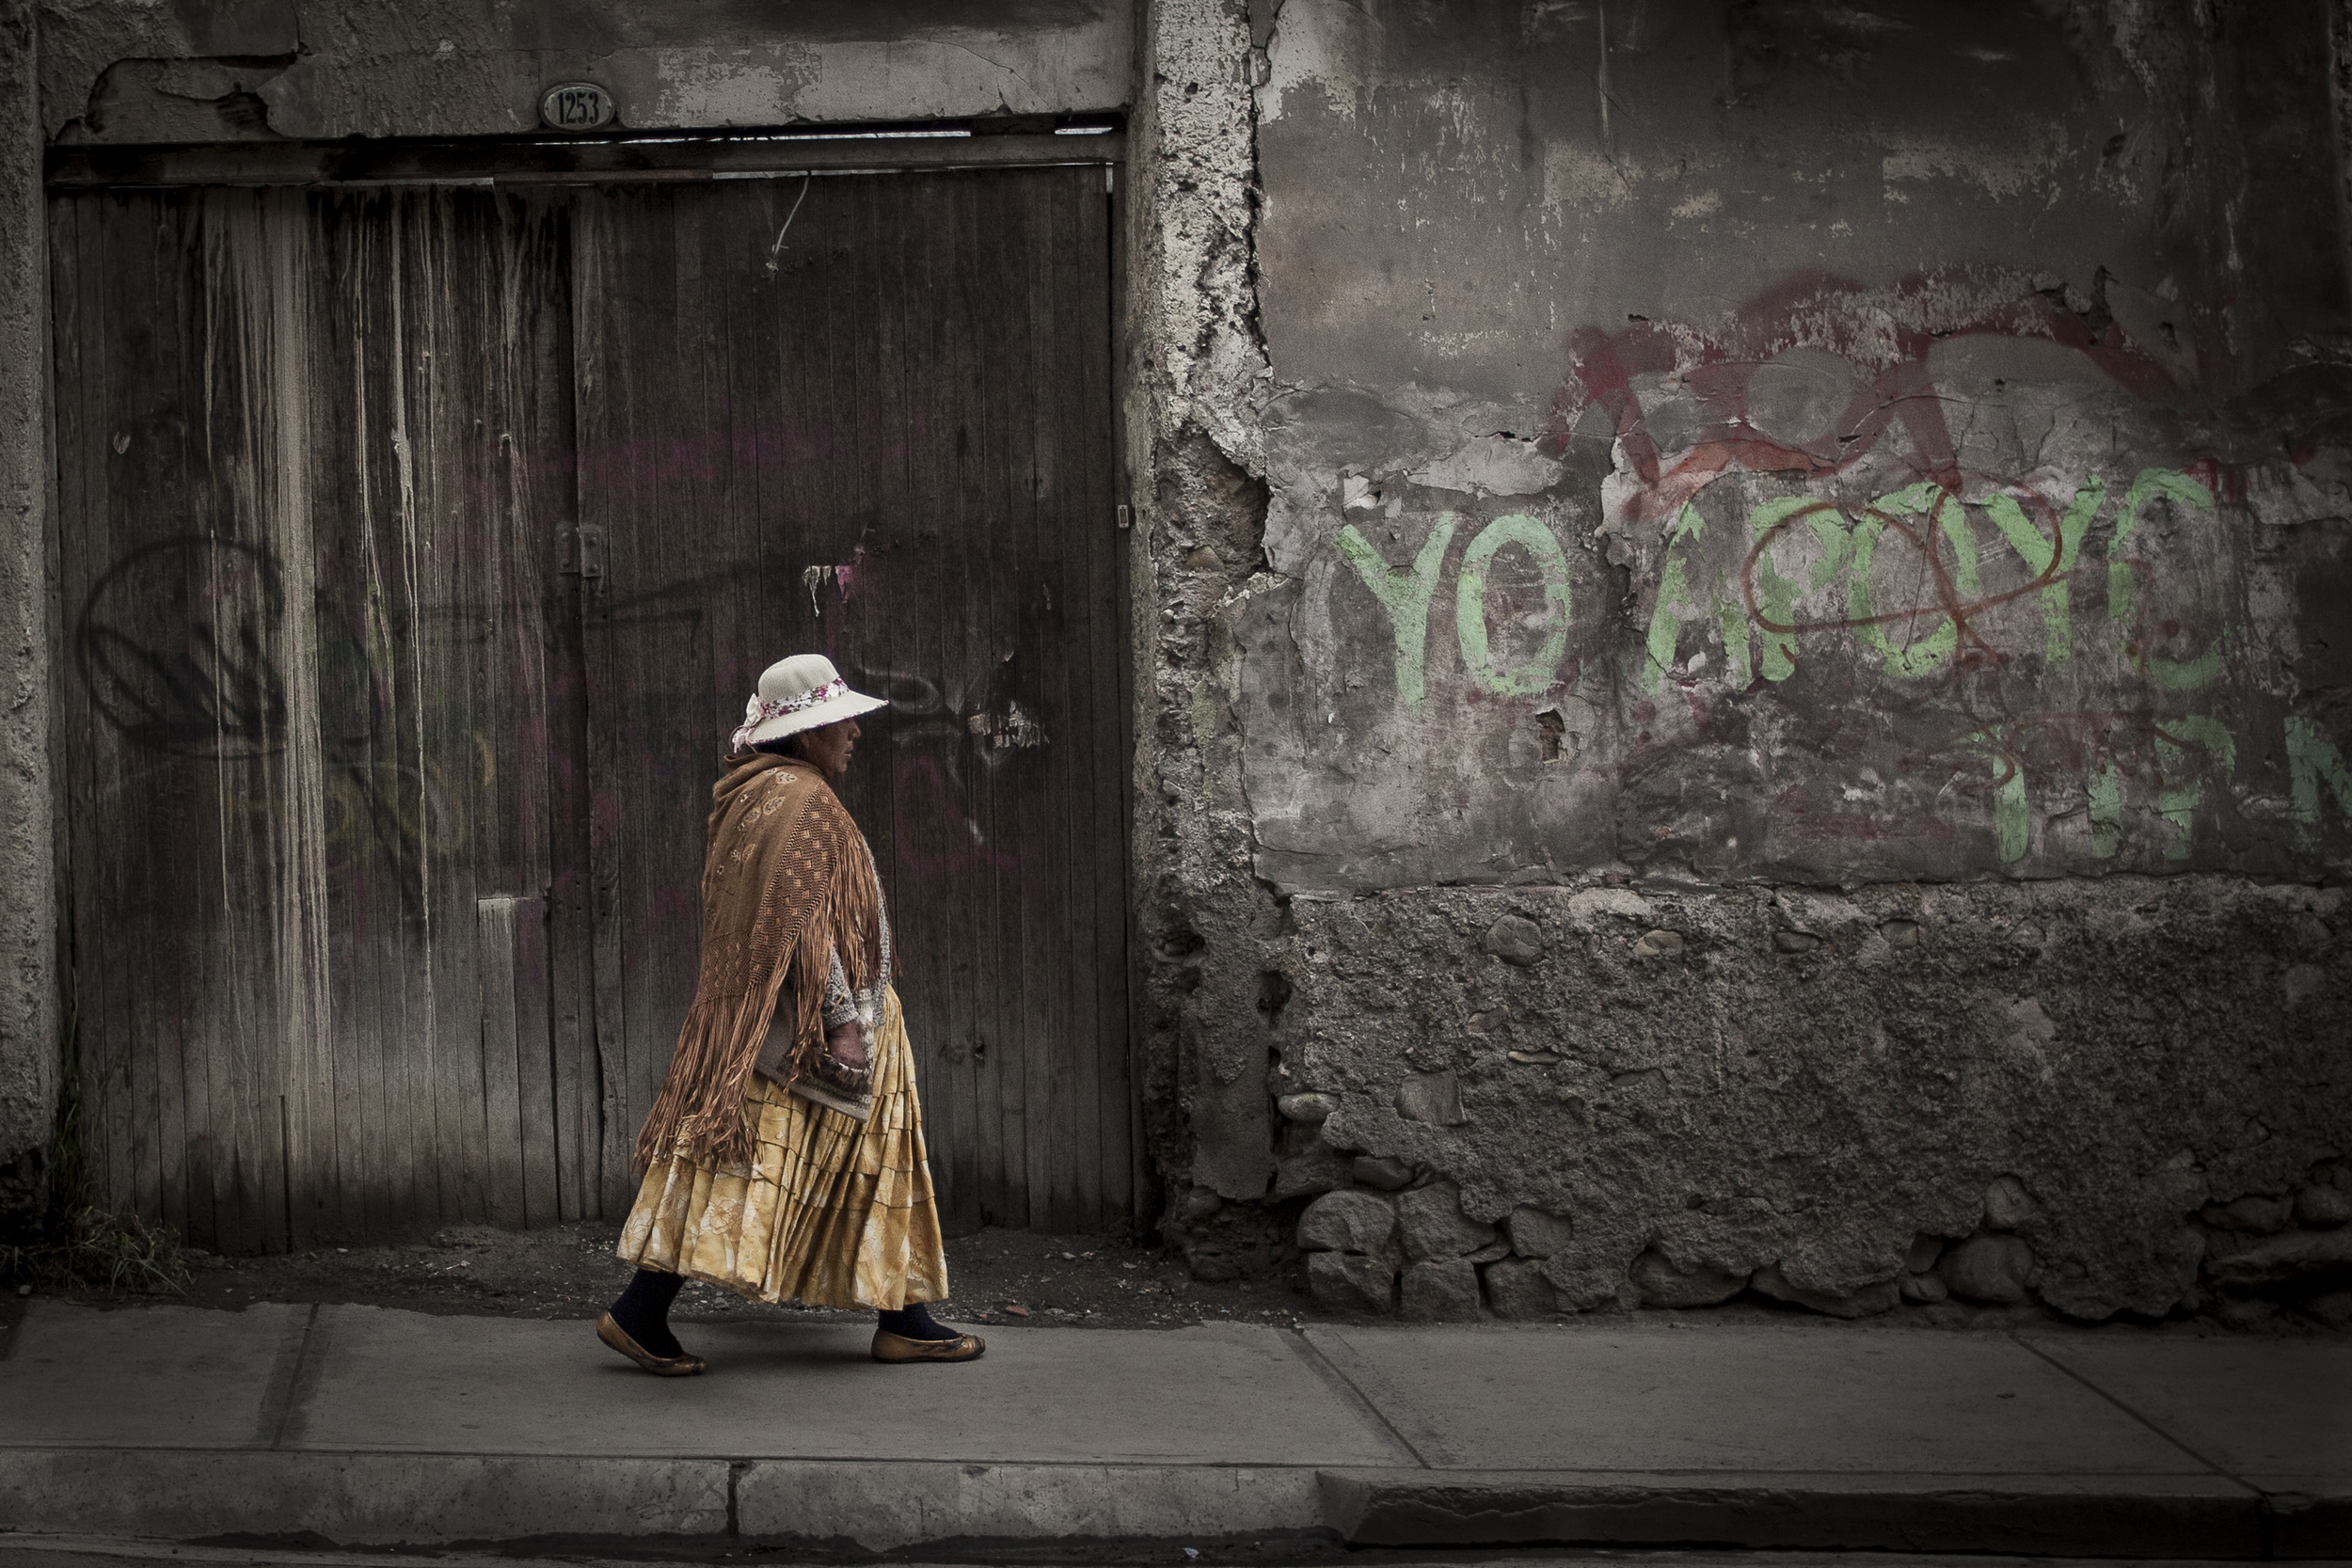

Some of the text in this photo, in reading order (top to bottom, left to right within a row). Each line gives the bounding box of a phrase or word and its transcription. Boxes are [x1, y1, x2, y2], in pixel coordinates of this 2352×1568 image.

[557, 92, 599, 124] 1253
[1332, 467, 2237, 712] YO APOYO
